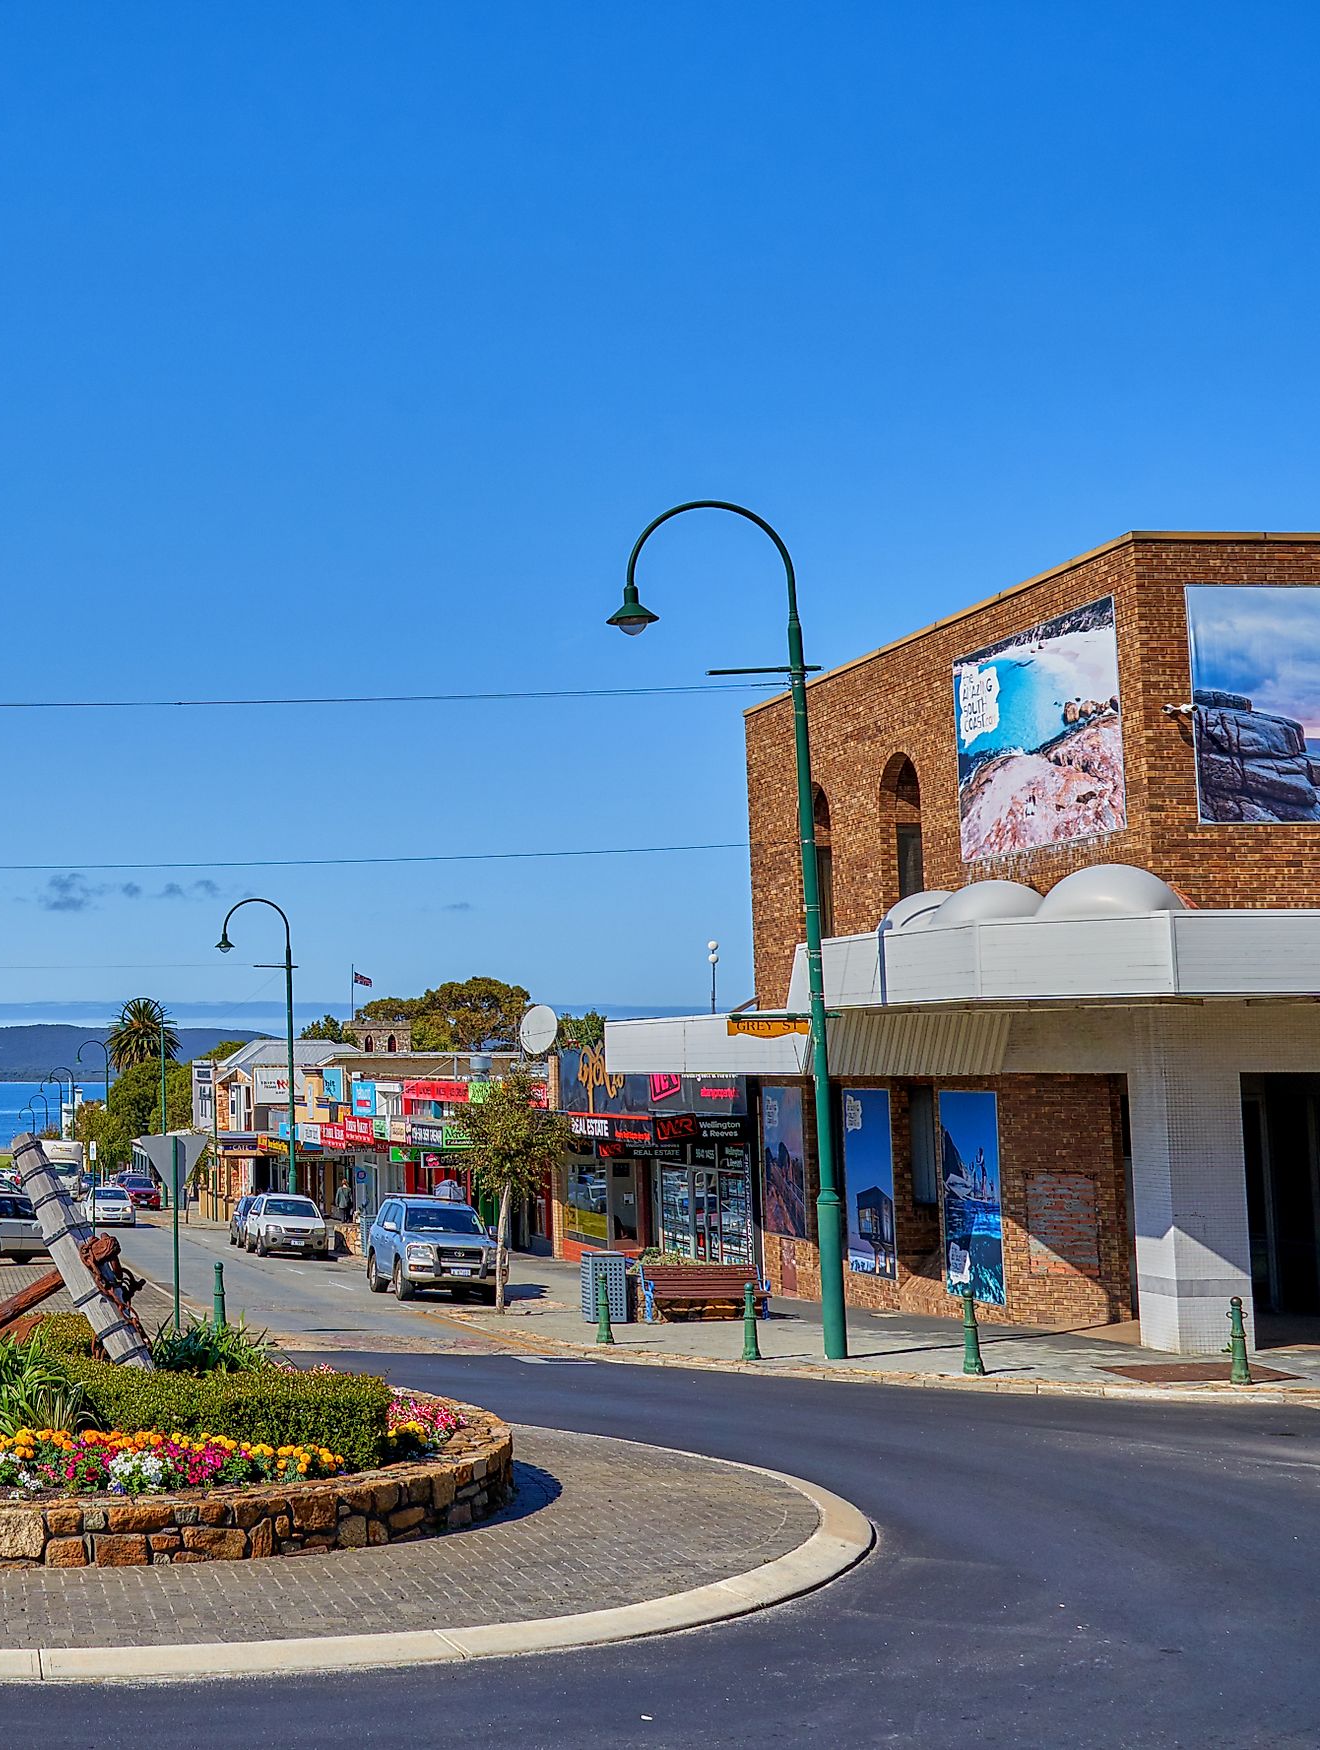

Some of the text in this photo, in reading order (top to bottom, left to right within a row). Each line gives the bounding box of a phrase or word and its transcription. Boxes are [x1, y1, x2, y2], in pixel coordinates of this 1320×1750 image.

[736, 1021, 797, 1031] GREY ST
[587, 1118, 610, 1137] ESTATE
[698, 1121, 741, 1130] Wellington
